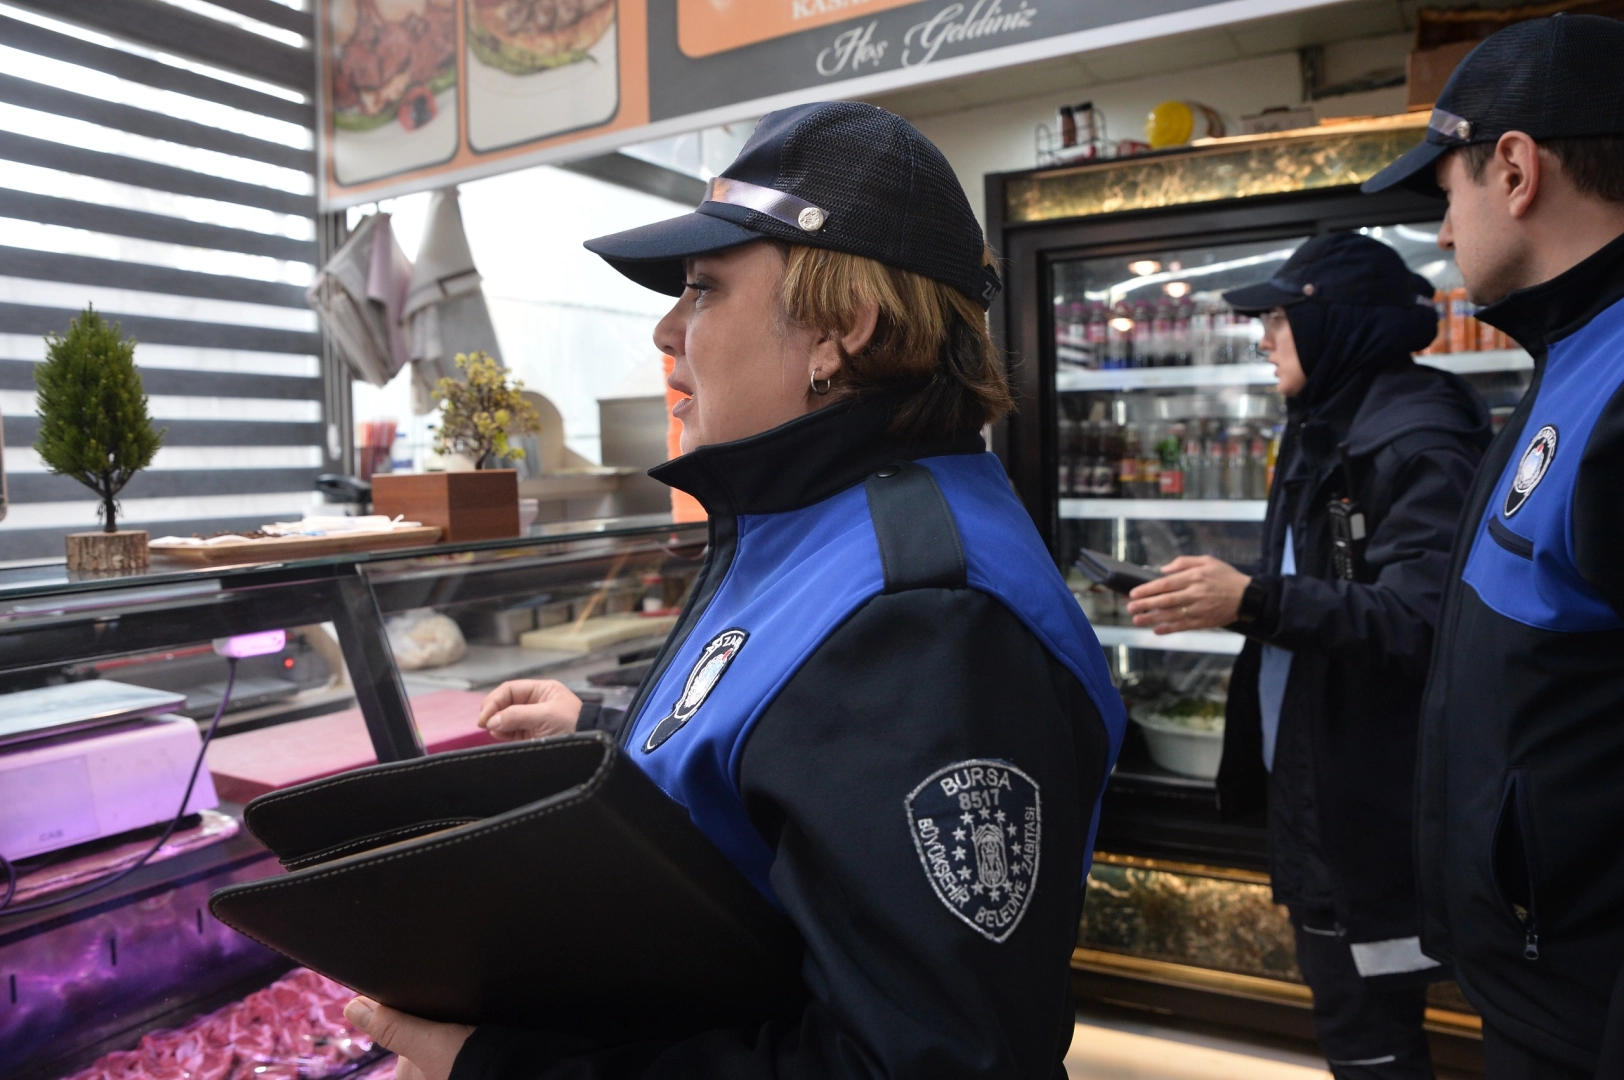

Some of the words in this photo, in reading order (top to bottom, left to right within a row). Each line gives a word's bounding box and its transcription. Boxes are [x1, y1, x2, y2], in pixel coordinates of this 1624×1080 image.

[816, 19, 888, 76] Hoş
[901, 0, 1038, 68] Geldiniz
[940, 767, 1012, 796] BURSA
[958, 788, 1000, 810] 8517
[917, 817, 971, 908] BÜYÜKŞEHİR
[1021, 806, 1036, 875] ZABITASI
